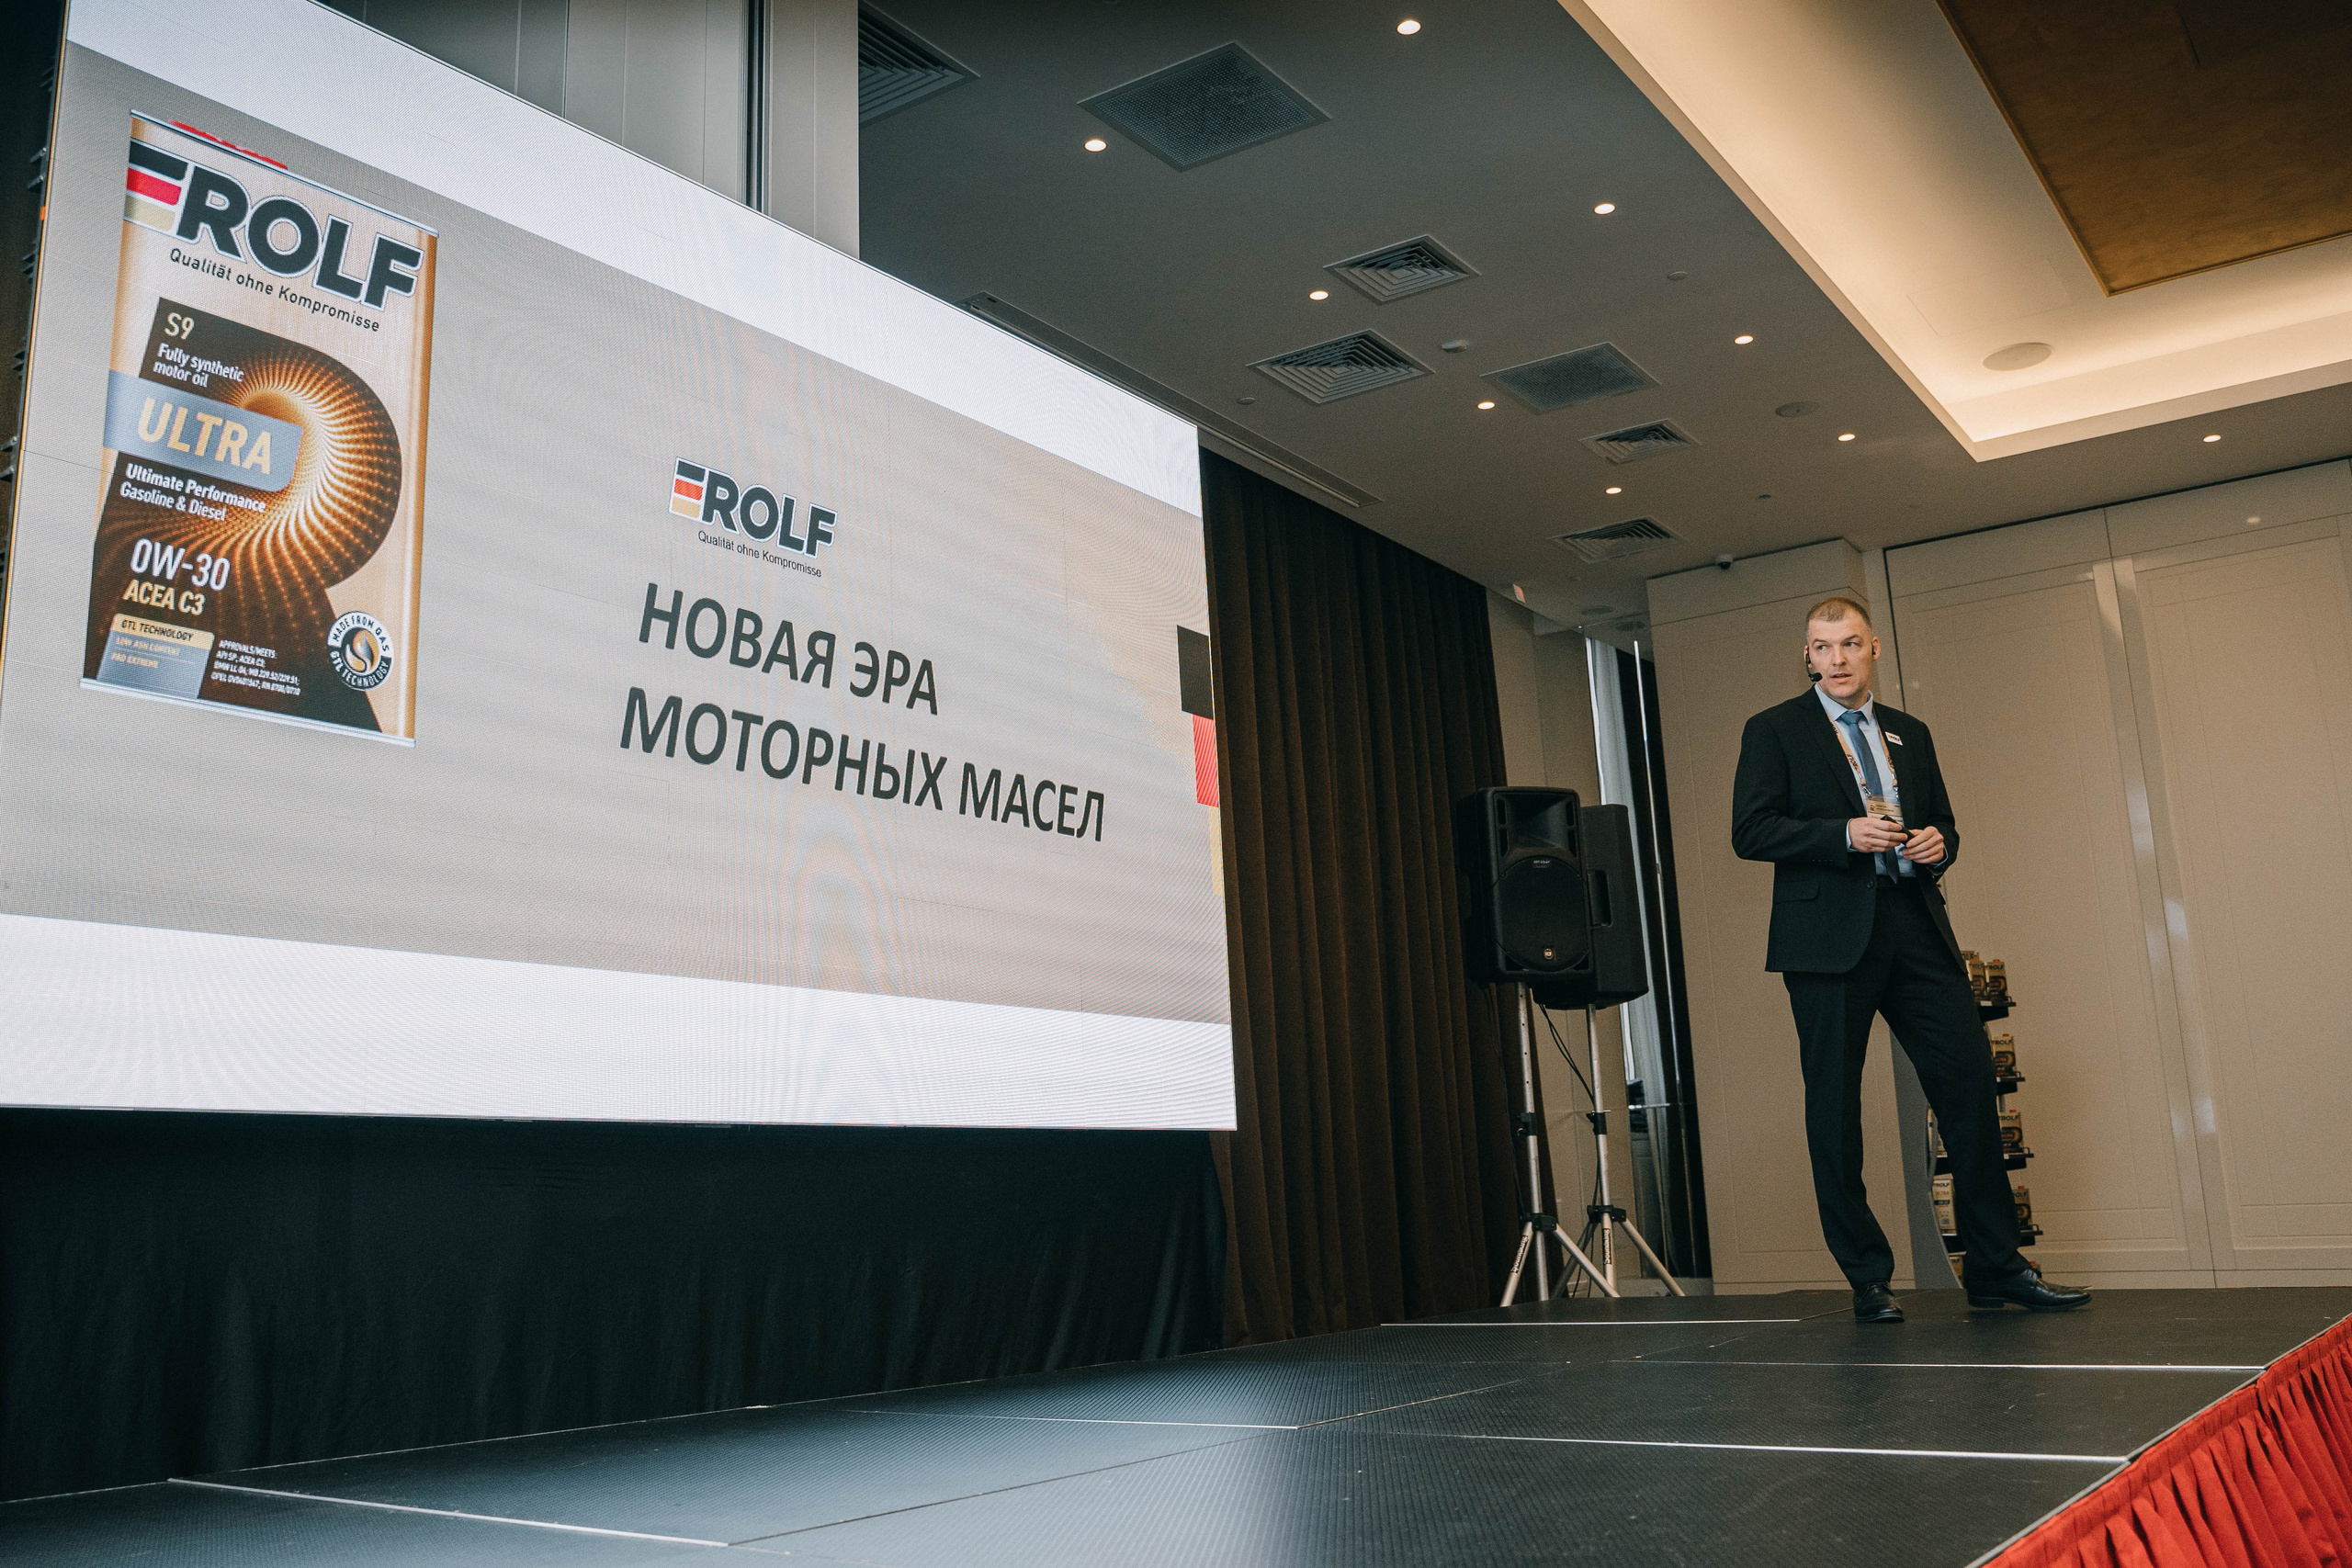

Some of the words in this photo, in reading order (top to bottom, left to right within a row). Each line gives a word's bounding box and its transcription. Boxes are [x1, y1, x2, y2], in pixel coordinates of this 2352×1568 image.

[176, 165, 425, 310] ROLF
[170, 248, 232, 280] Qualität
[236, 273, 274, 296] ohne
[278, 285, 379, 333] Kompromisse
[164, 312, 195, 340] S9
[153, 361, 191, 381] motor
[192, 373, 209, 388] oil
[157, 343, 190, 366] Fully
[190, 355, 244, 382] synthetic
[138, 396, 272, 475] ULTRA
[119, 481, 175, 509] Gasoline
[175, 496, 186, 512] &
[188, 498, 227, 522] Diesel
[125, 462, 184, 491] Ultimate
[185, 479, 266, 513] Performance
[703, 469, 837, 558] ROLF
[130, 537, 230, 592] 0W-30
[698, 530, 734, 551] Qualität
[737, 544, 760, 559] ohne
[763, 550, 821, 578] Kompromisse
[122, 579, 175, 611] ACEA
[178, 591, 206, 616] C3
[121, 619, 136, 631] GTL
[140, 623, 194, 641] TECHNOLOGY
[333, 618, 349, 642] MADE
[351, 615, 374, 629] FROM
[376, 627, 390, 652] GAS
[639, 582, 836, 689] НОВАЯ
[849, 642, 938, 716] ЭРА
[330, 650, 344, 672] GTL
[342, 661, 389, 687] TECHNOLOGY
[619, 686, 947, 812] МОТОРНЫХ
[958, 762, 1105, 842] МАСЕЛ
